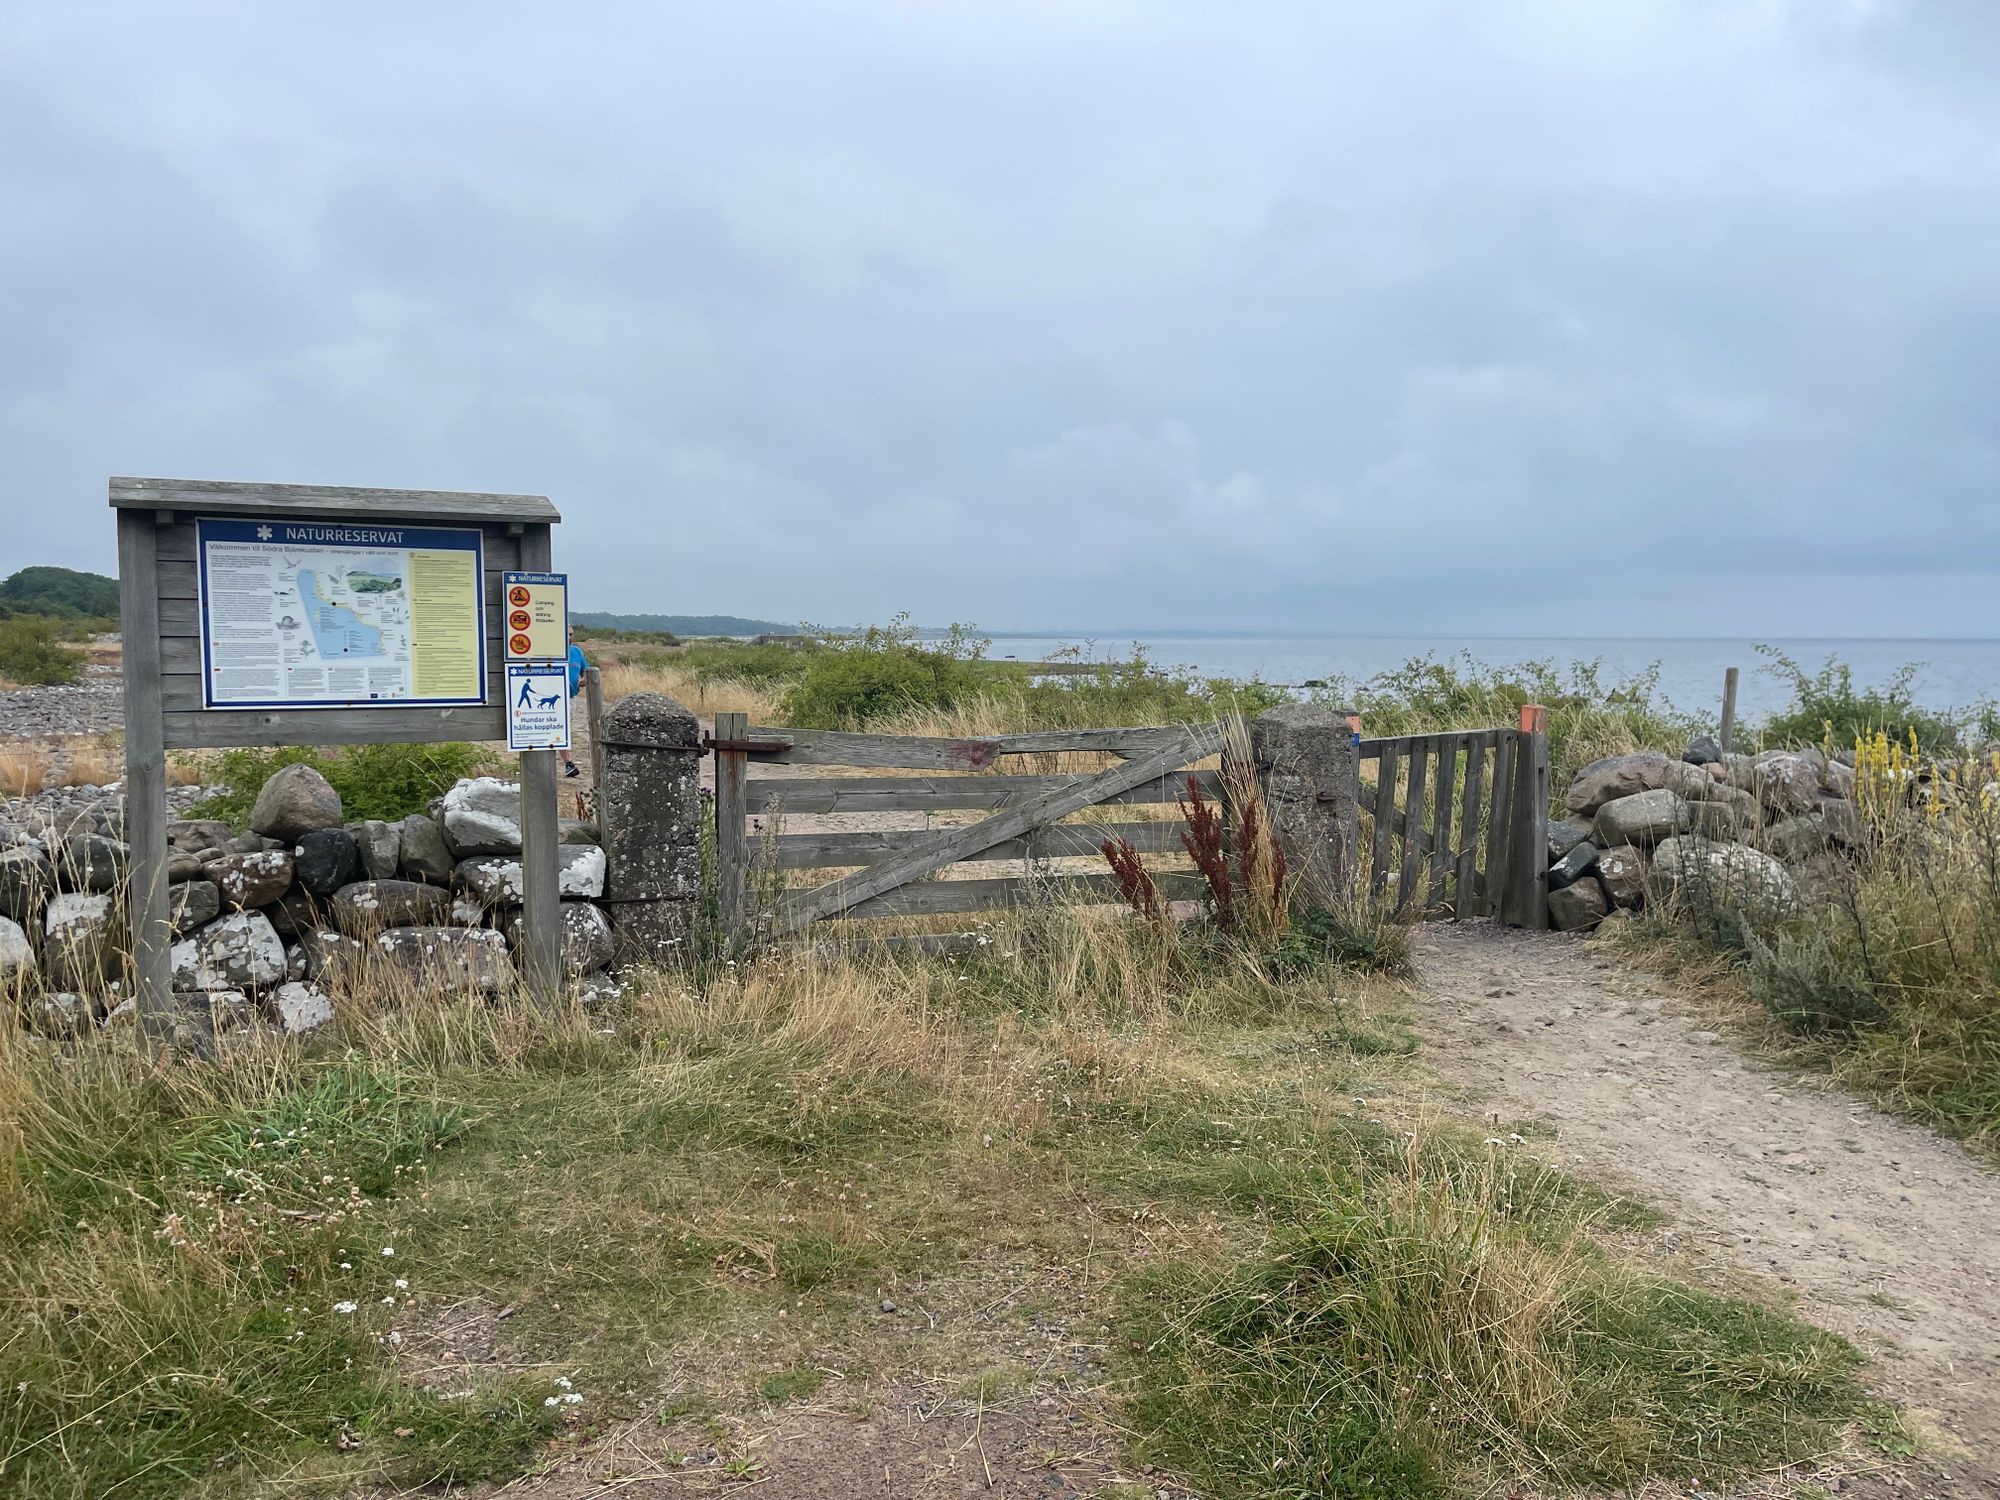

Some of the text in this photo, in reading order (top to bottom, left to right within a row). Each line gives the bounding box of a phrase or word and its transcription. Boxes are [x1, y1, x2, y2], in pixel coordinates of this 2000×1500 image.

[286, 527, 404, 543] NATURRESERVAT
[209, 543, 251, 552] Välkommen
[252, 544, 260, 552] till
[262, 545, 282, 553] Södra
[518, 575, 563, 583] NATURRESERVAT
[534, 723, 564, 731] kopplade
